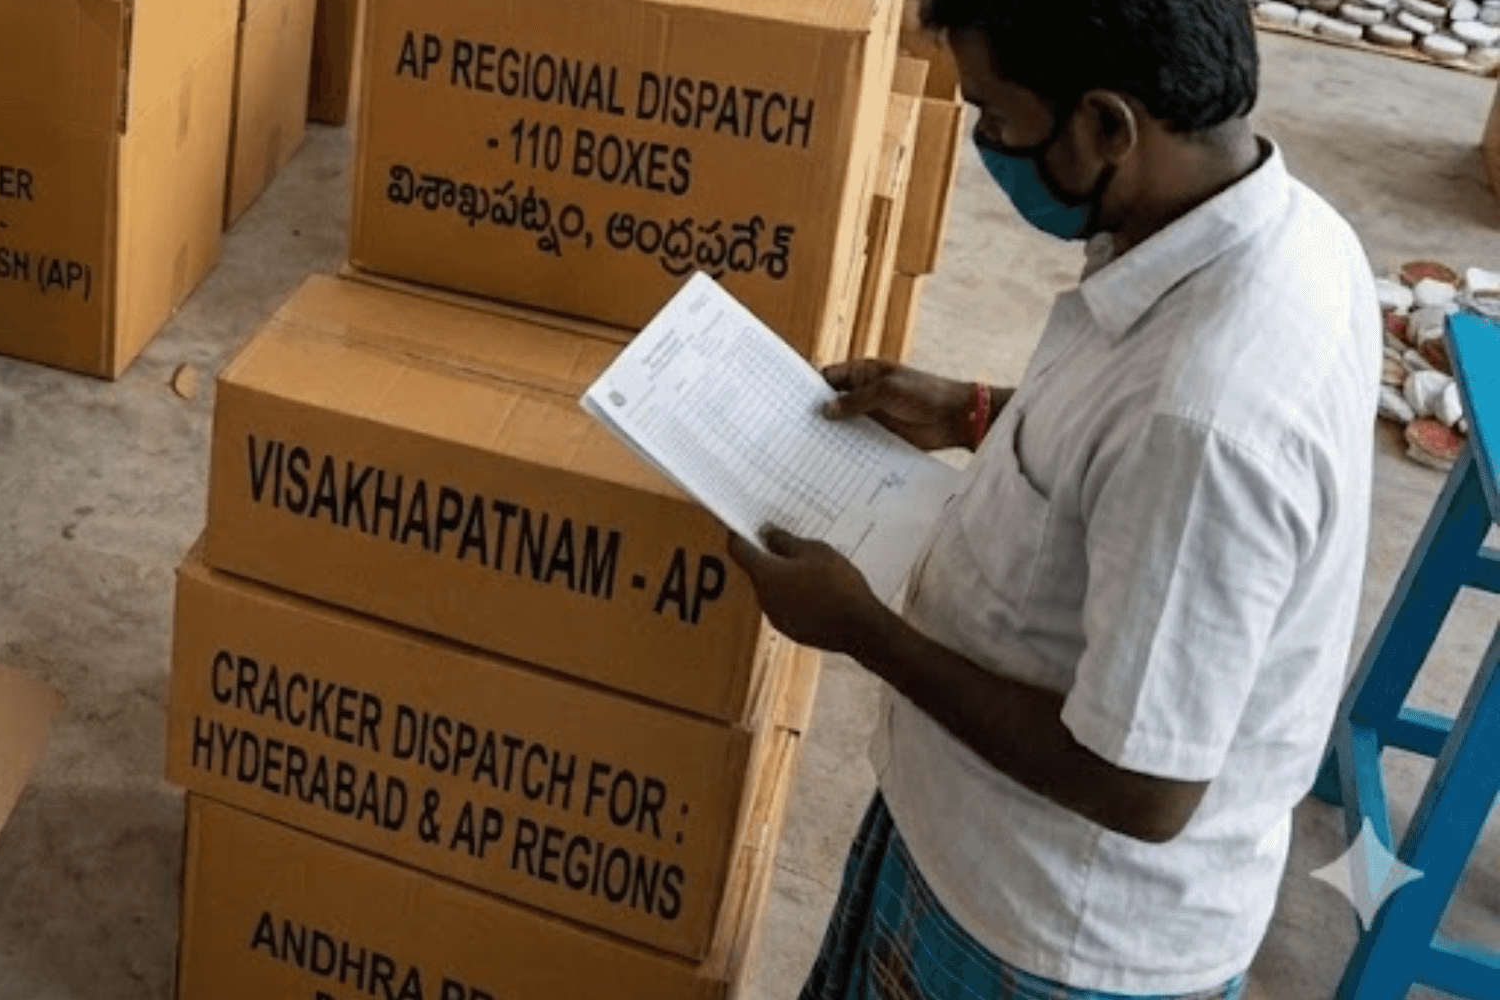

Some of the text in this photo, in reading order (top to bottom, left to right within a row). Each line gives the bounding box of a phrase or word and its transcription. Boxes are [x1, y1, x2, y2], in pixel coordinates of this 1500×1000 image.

[396, 30, 815, 149] AP REGIONAL DISPATCH
[510, 117, 562, 172] 110
[573, 129, 692, 197] BOXES
[37, 255, 92, 302] (AP)
[246, 433, 621, 601] VISAKHAPATNAM
[654, 546, 728, 626] AP
[211, 649, 383, 753] CRACKER
[393, 704, 576, 808] DISPATCH
[585, 762, 668, 841] FOR
[191, 716, 685, 922] HYDERABAD & AP REGIONS
[251, 911, 423, 1000] ANDHRA
